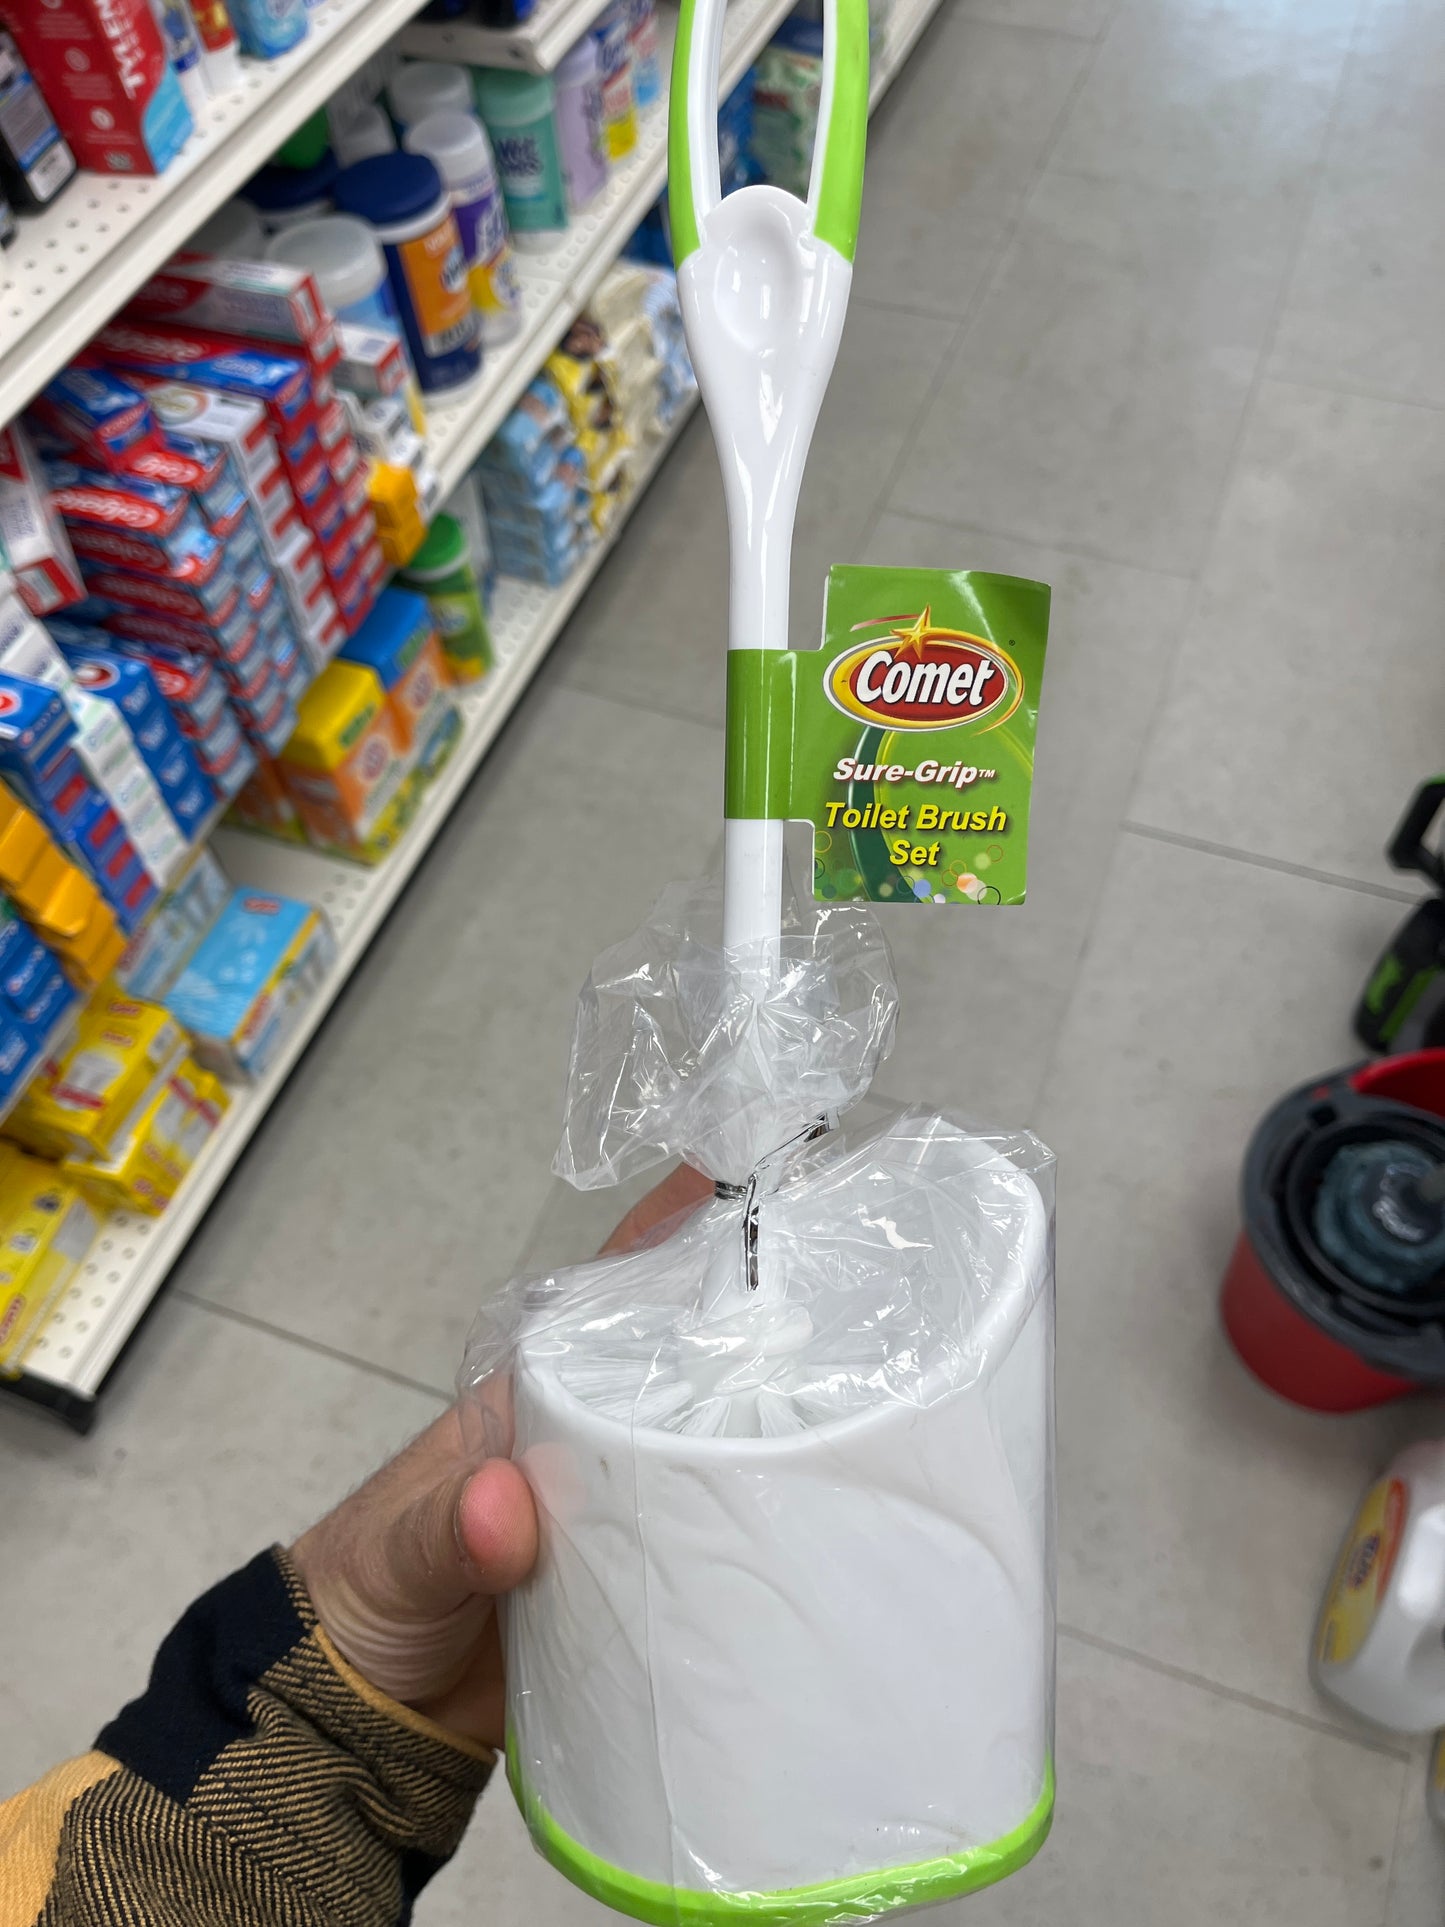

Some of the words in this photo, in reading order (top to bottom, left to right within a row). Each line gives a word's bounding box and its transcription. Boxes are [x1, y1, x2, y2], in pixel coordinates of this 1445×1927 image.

[856, 650, 996, 706] Comet
[825, 802, 910, 830] Toilet
[916, 804, 1006, 831] Brush
[889, 839, 940, 866] Set
